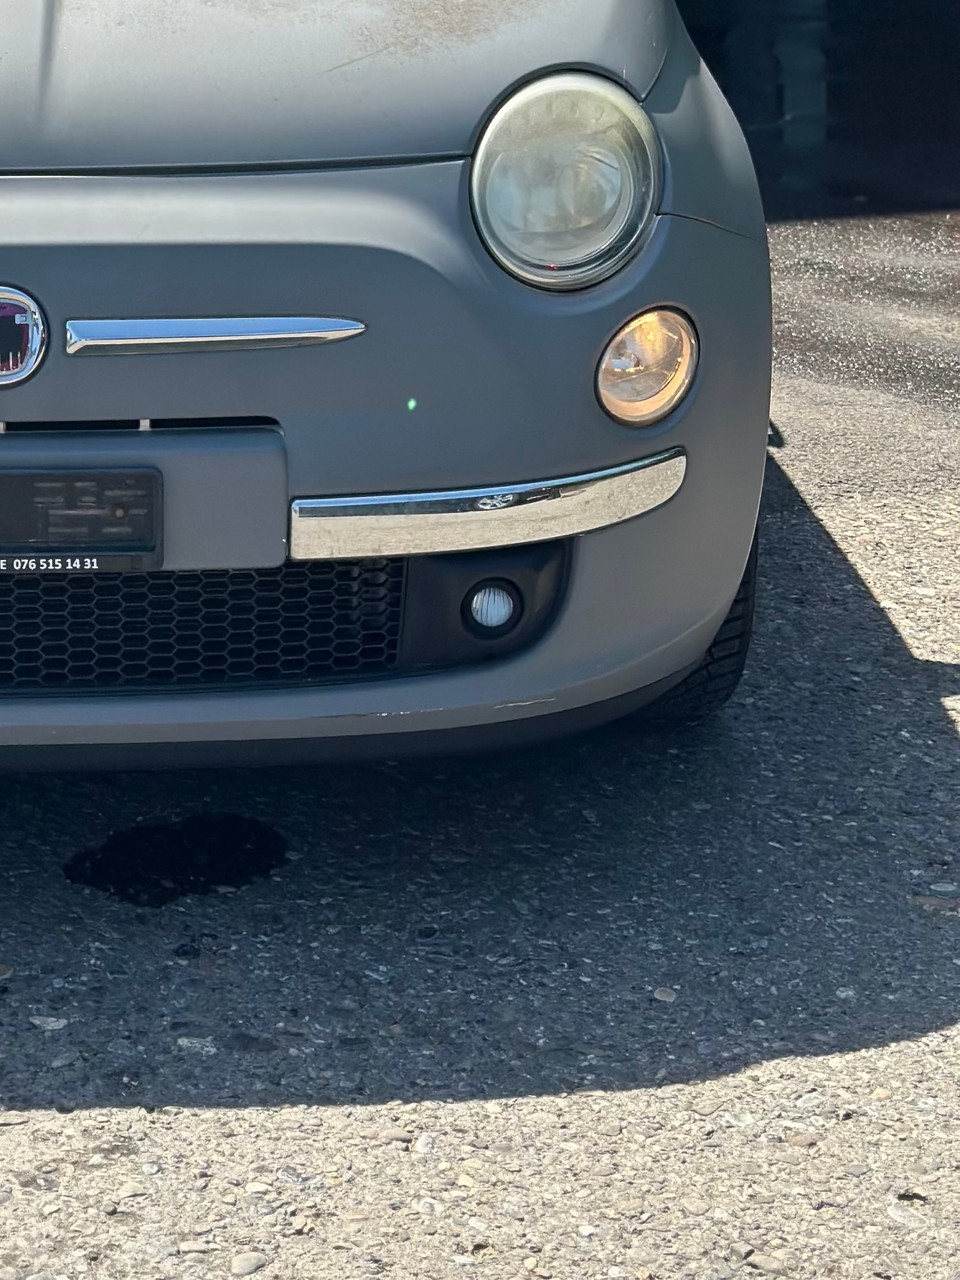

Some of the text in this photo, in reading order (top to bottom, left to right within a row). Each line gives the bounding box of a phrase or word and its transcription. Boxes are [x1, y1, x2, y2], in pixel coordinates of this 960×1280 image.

[13, 558, 36, 569] 076
[39, 558, 61, 569] 515
[65, 558, 80, 569] 14
[83, 558, 99, 569] 31
